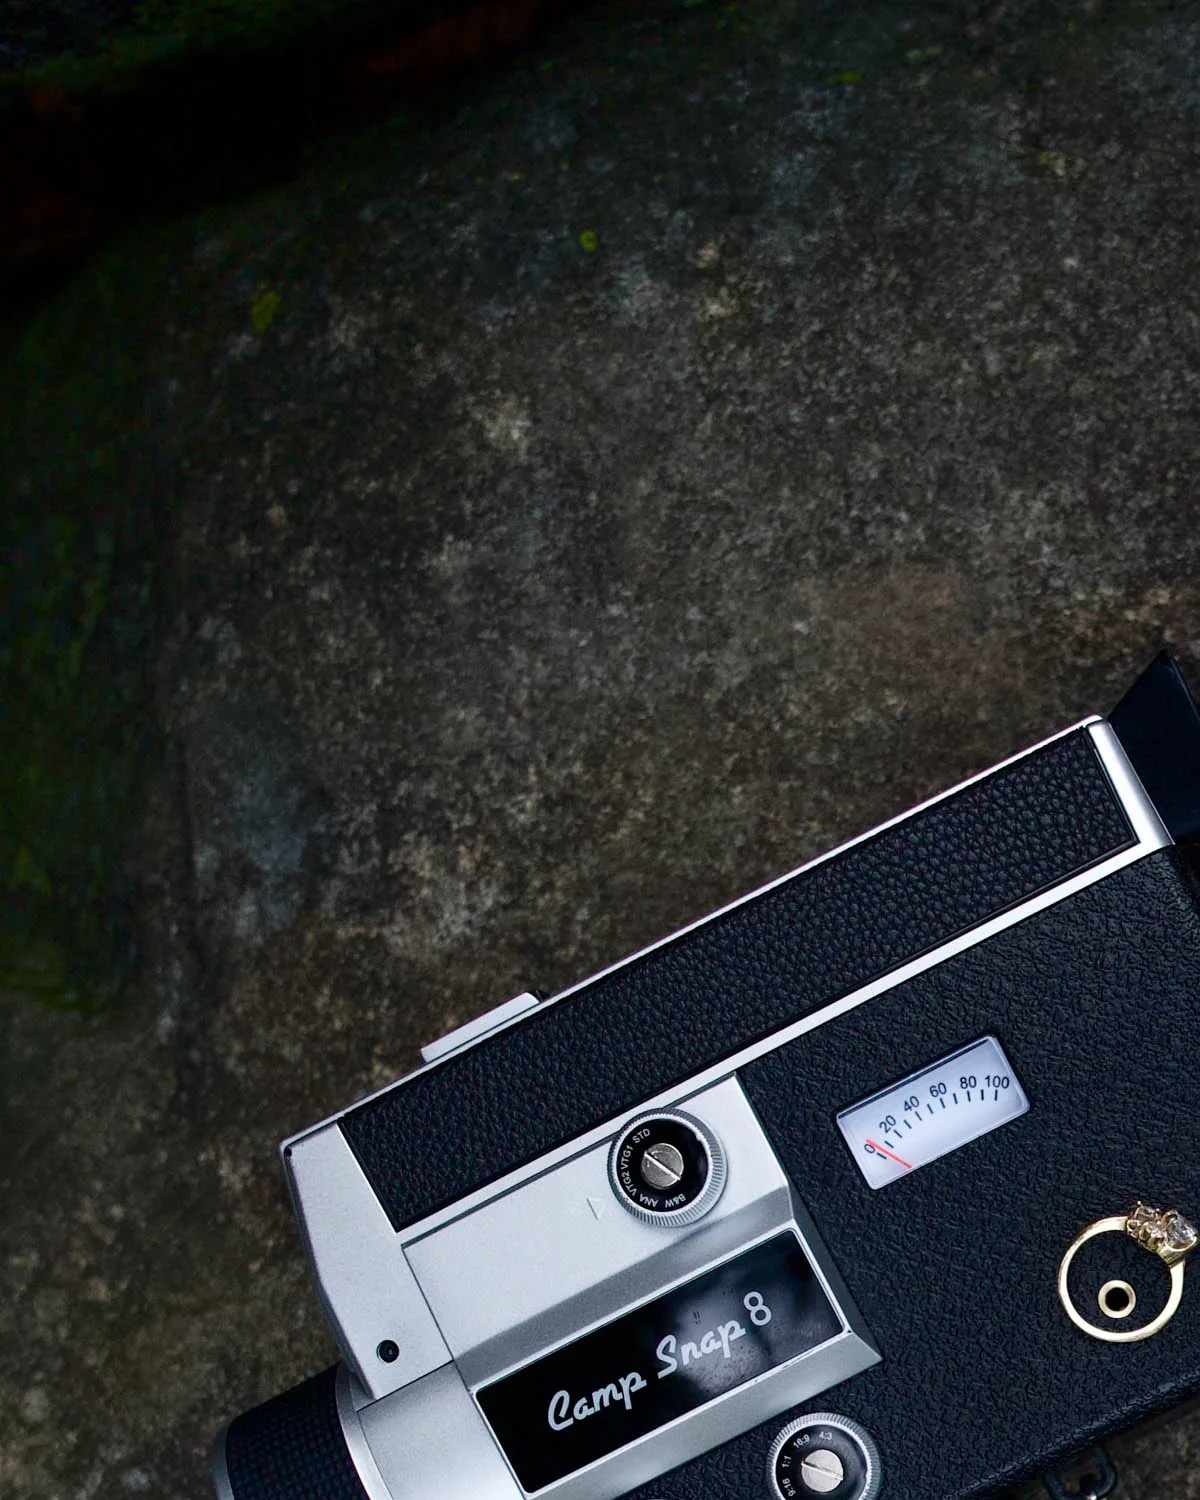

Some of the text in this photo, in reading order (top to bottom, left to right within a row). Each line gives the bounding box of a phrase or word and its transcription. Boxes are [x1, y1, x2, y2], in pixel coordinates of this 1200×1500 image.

[879, 1115, 896, 1133] 20
[903, 1095, 920, 1112] 40
[929, 1082, 947, 1098] 60
[959, 1075, 977, 1090] 80
[984, 1075, 1010, 1089] 100
[632, 1128, 651, 1144] STD
[620, 1145, 633, 1169] VTG1
[621, 1172, 638, 1196] VTG2
[639, 1193, 659, 1208] ANA
[664, 1193, 687, 1208] B&W
[547, 1291, 772, 1431] Camp Snap 8
[793, 1434, 810, 1449] 16:9
[819, 1431, 833, 1440] 4:3
[782, 1455, 792, 1468] 1:1
[782, 1478, 796, 1497] 9:16
